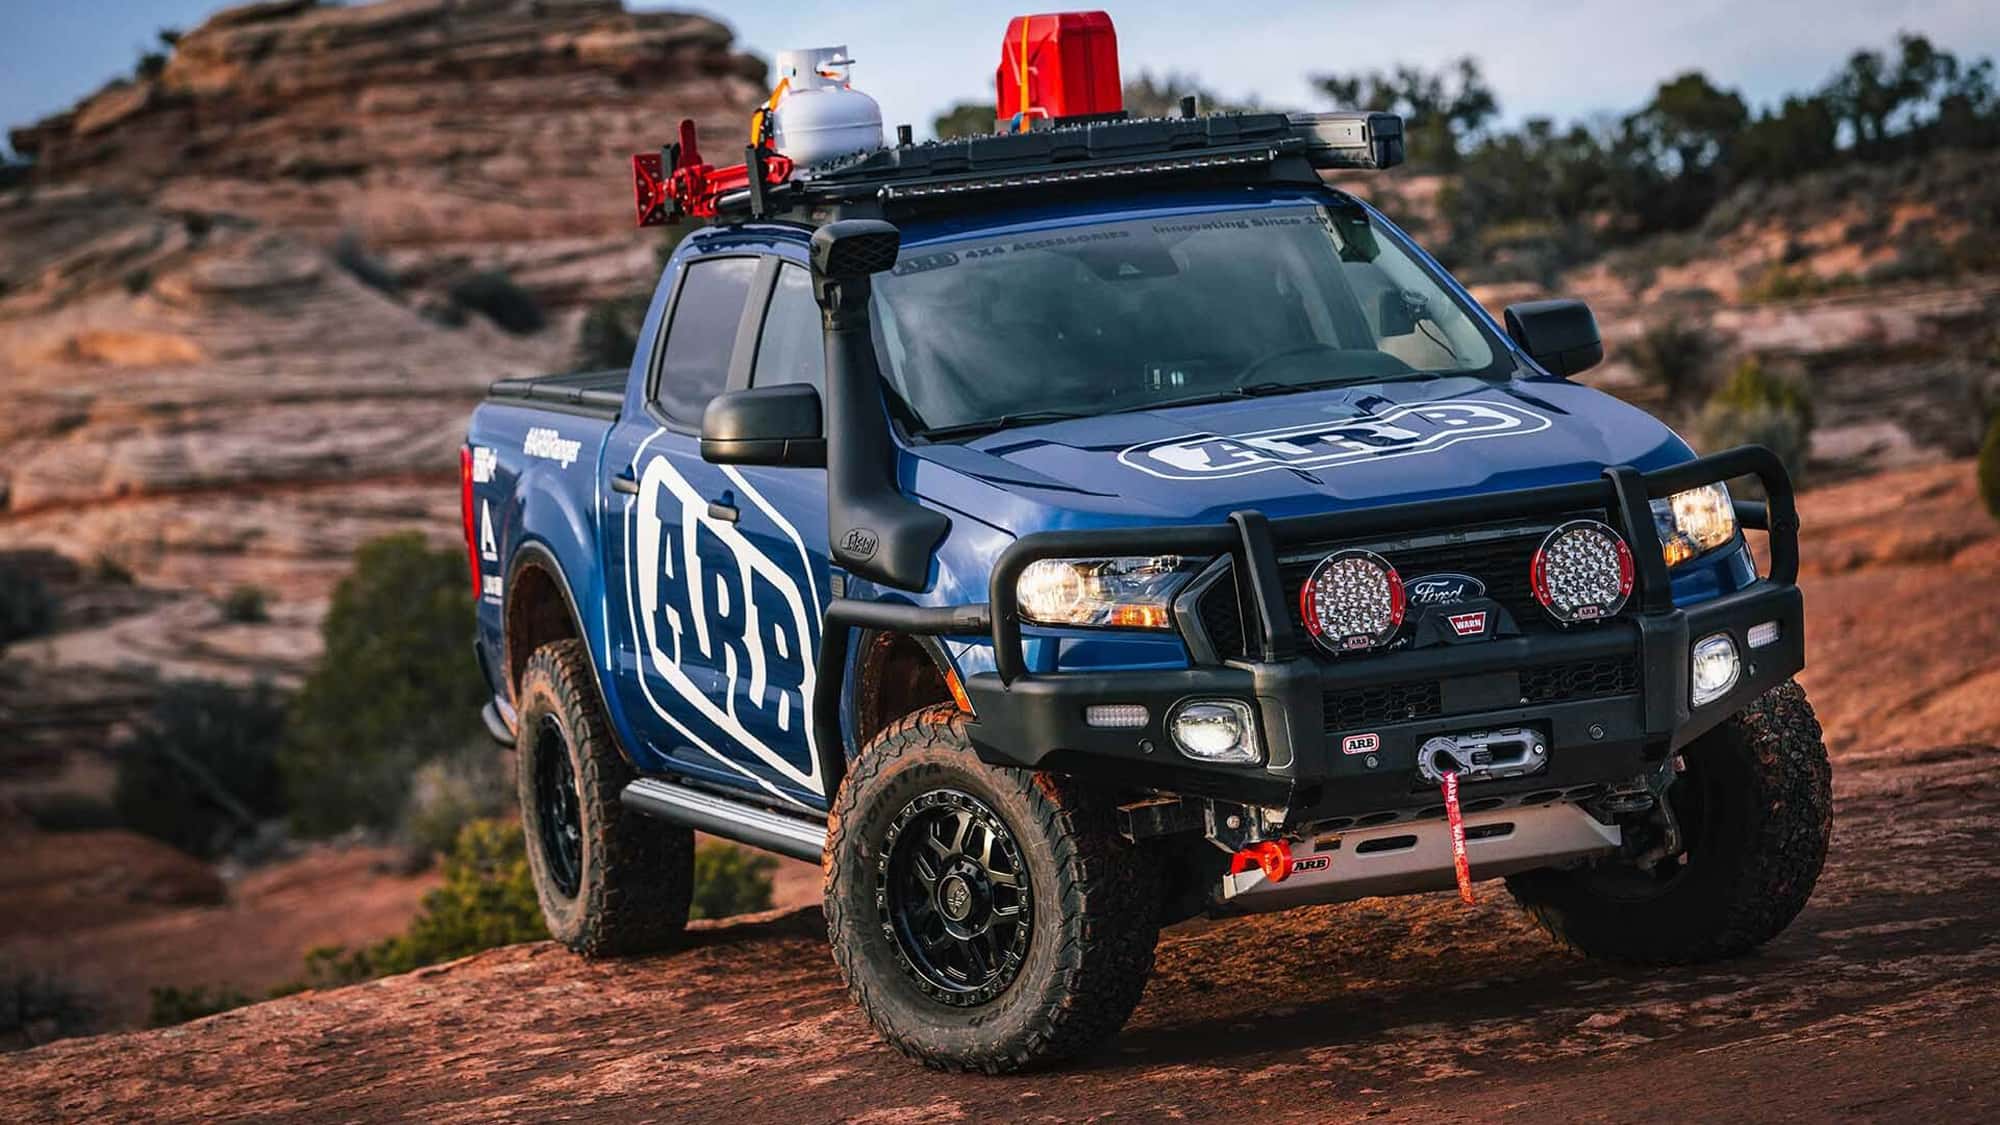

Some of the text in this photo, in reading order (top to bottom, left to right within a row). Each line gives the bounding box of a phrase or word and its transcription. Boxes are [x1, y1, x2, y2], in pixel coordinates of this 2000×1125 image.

[1411, 581, 1465, 606] Ford
[650, 478, 813, 778] ARB
[1455, 618, 1482, 630] WARN
[1348, 738, 1374, 750] ARB
[1294, 859, 1326, 871] ARB
